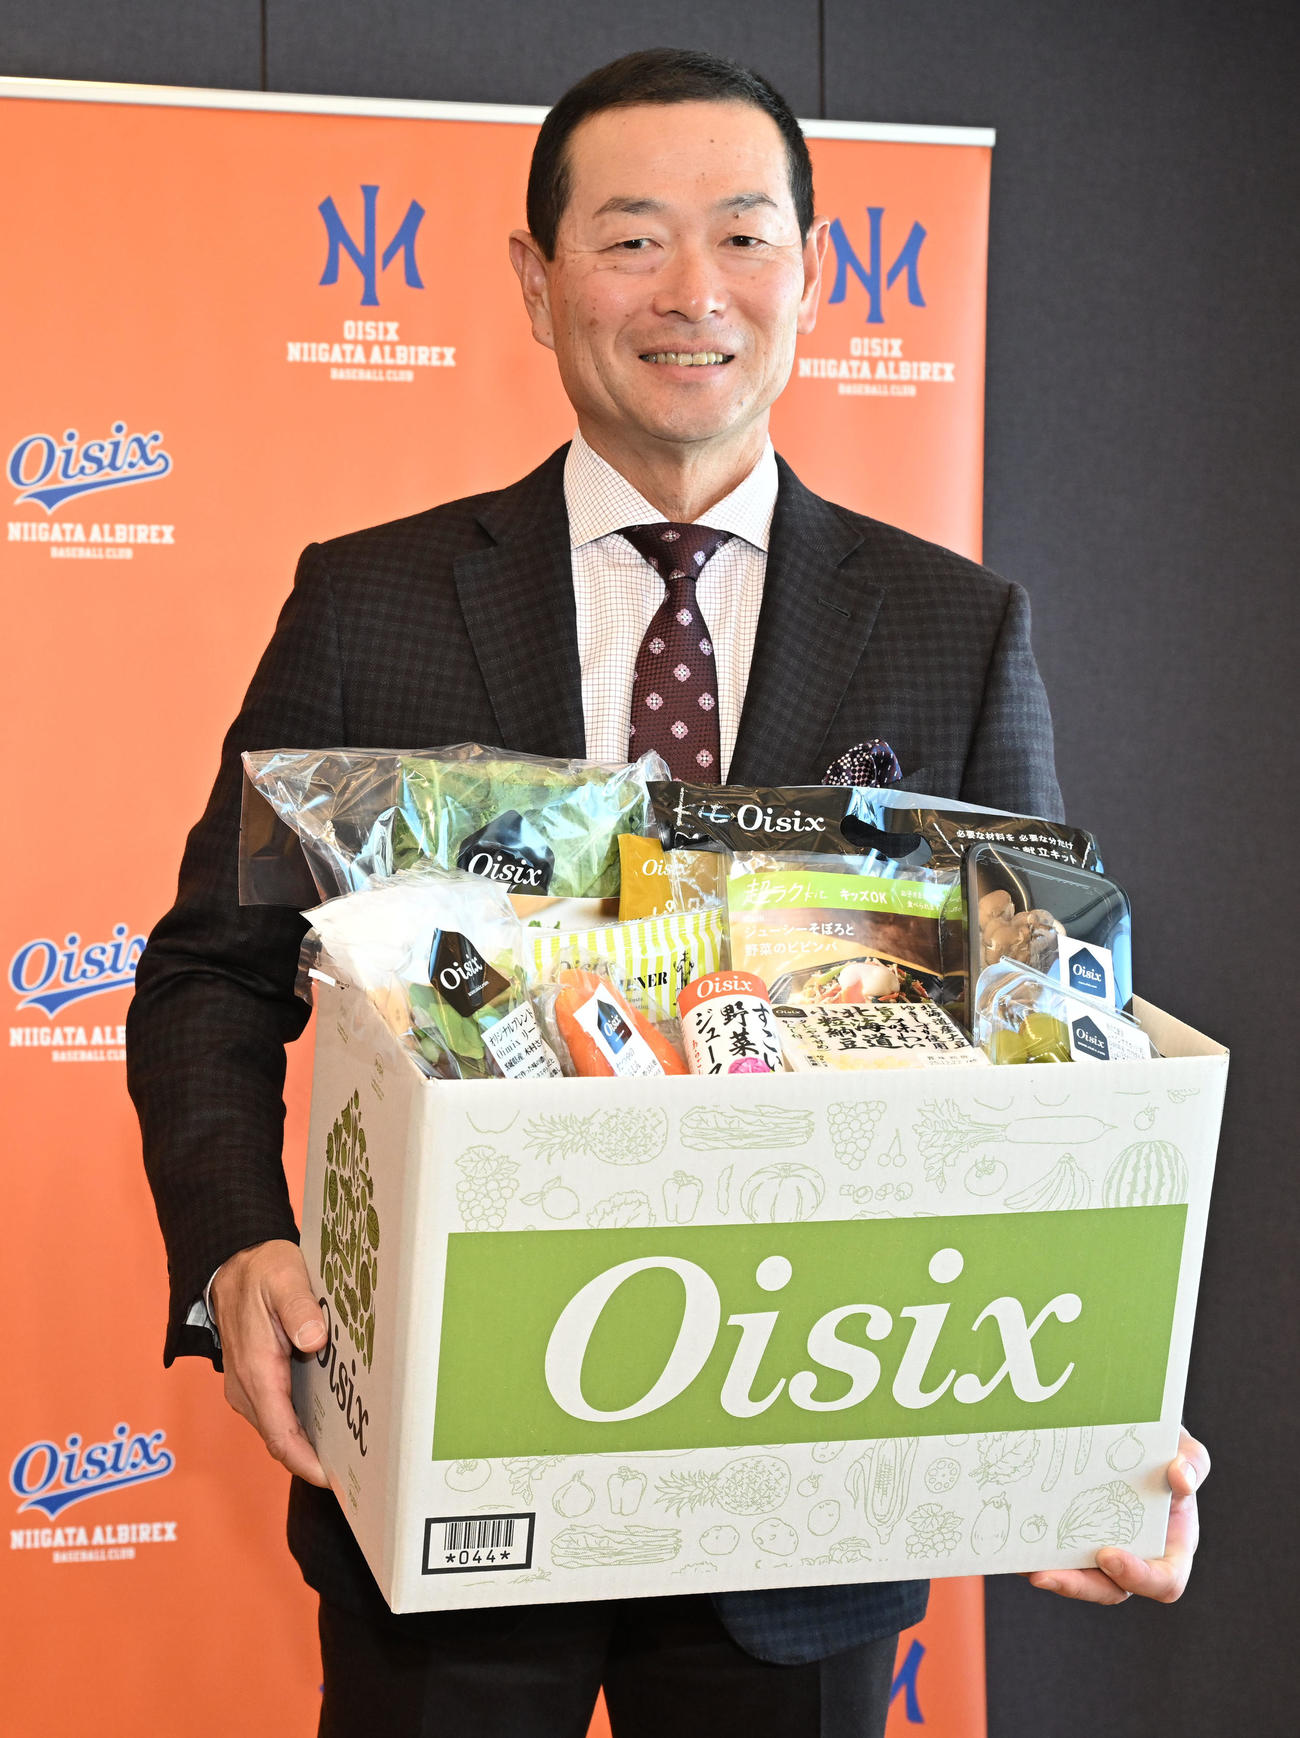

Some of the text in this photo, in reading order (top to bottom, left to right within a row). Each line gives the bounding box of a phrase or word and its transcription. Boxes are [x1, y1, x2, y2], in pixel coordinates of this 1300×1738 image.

[343, 320, 400, 341] OISIX
[286, 341, 456, 367] NIIGATA ALBIREX
[849, 337, 904, 358] OISIX
[330, 367, 415, 383] BASEBALL CLUB
[798, 358, 956, 382] NIIGATA ALBIREX
[837, 383, 917, 398] BASEBALL CLUB
[7, 420, 168, 492] Oisix
[7, 521, 176, 545] NIIGATA ALBIREX
[50, 545, 134, 561] BASEBALL CLUB
[737, 804, 827, 833] Oisix
[955, 829, 1016, 843] 必要な材料を
[468, 852, 543, 887] Oisix
[839, 889, 889, 905] キッズOK
[744, 922, 856, 939] ジューシーそぼろと
[744, 940, 838, 957] 野菜のビビンバ
[439, 952, 484, 990] Oisix
[1072, 963, 1102, 982] Oisix
[696, 975, 753, 998] Oisix
[9, 1025, 88, 1047] NIIGATA
[603, 1013, 622, 1038] Oisix
[720, 1000, 760, 1057] 野菜
[810, 1006, 869, 1051] 小粒納豆
[841, 1005, 903, 1049] 北海道
[1076, 1028, 1105, 1049] Oisix
[51, 1049, 106, 1063] BASEBALL
[545, 1248, 1083, 1422] Oisix
[316, 1297, 369, 1457] Oisix
[9, 1421, 170, 1499] Oisix
[10, 1521, 178, 1550] NIIGATA ALBIREX
[53, 1547, 136, 1564] BASEBALL CLUB
